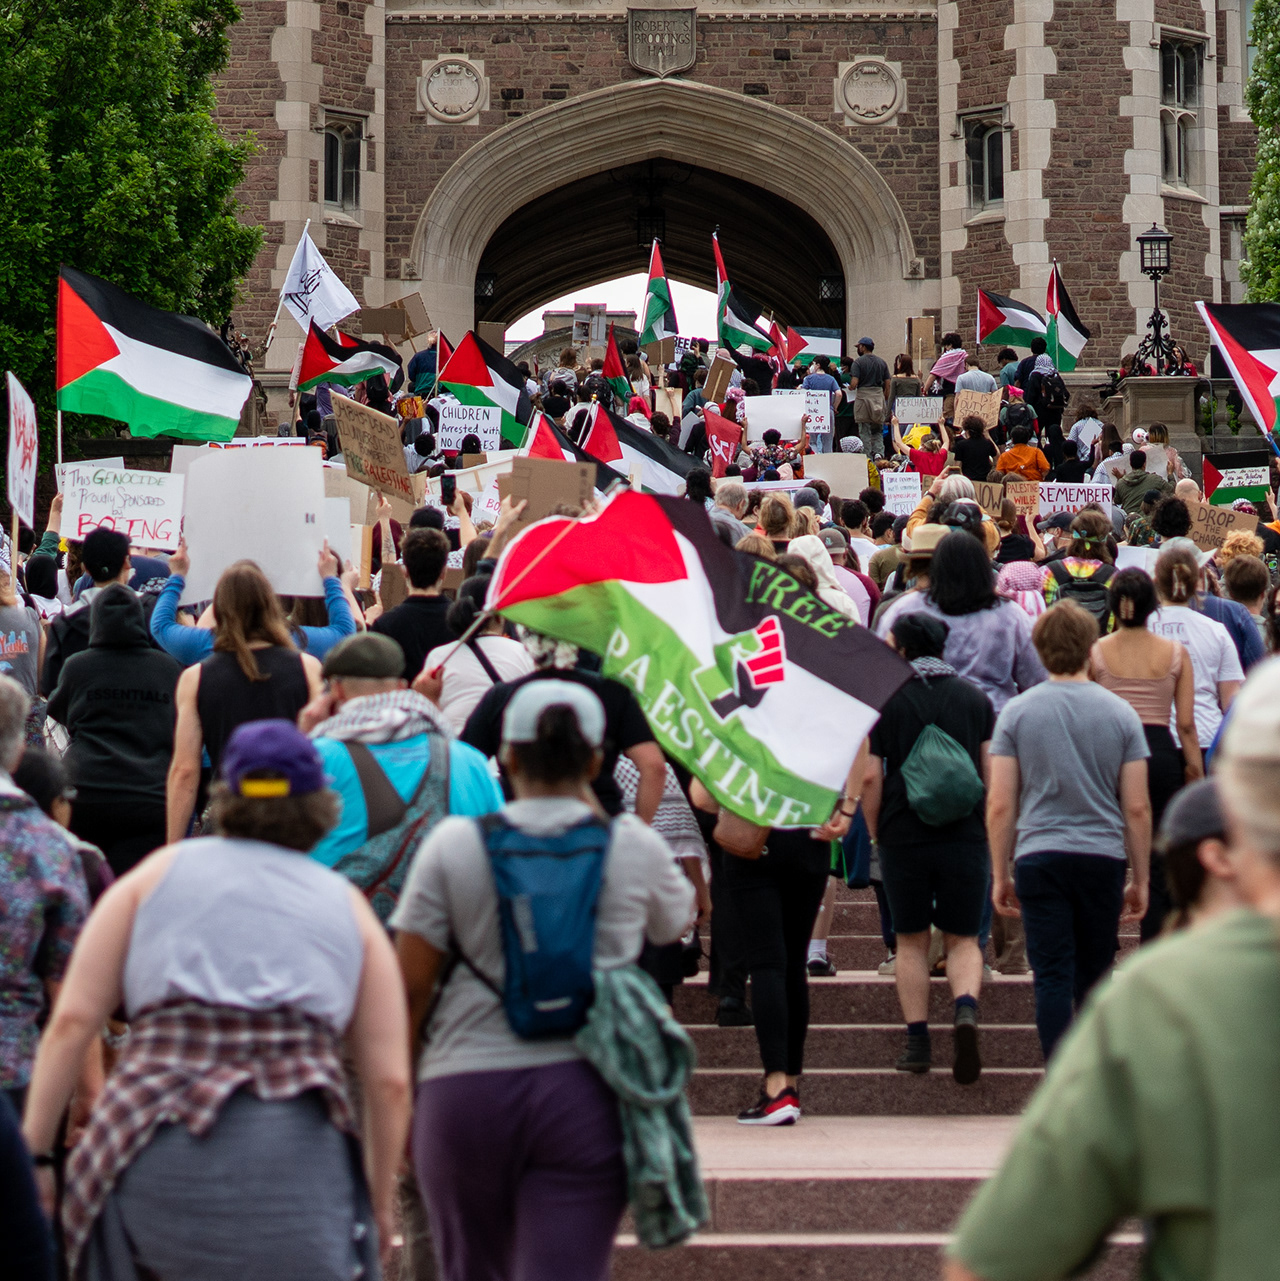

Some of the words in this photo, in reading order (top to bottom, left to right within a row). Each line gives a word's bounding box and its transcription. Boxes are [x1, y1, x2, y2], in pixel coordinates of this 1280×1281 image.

[634, 20, 678, 32] ROBERT
[634, 32, 691, 45] BROOKINGS
[648, 45, 678, 57] HALL
[674, 336, 690, 350] REE
[896, 397, 939, 409] MERCHANTS
[441, 406, 490, 421] CHILDREN
[814, 415, 825, 423] OF
[441, 423, 479, 434] Arrested
[482, 423, 500, 435] with
[440, 438, 452, 448] NO
[69, 469, 91, 487] This
[92, 468, 167, 487] GENOCIDE
[363, 459, 413, 496] PALESTINE
[1007, 483, 1038, 494] PALESTINE
[1039, 486, 1111, 503] REMEMBER
[78, 487, 116, 510] Proudly
[1028, 495, 1037, 505] BE
[1197, 506, 1236, 528] DROP
[1204, 523, 1222, 535] THE
[1192, 530, 1226, 548] CHARGE
[744, 559, 856, 640] FREE
[86, 688, 170, 705] ESSENTIALS
[606, 627, 811, 826] PAESTINE
